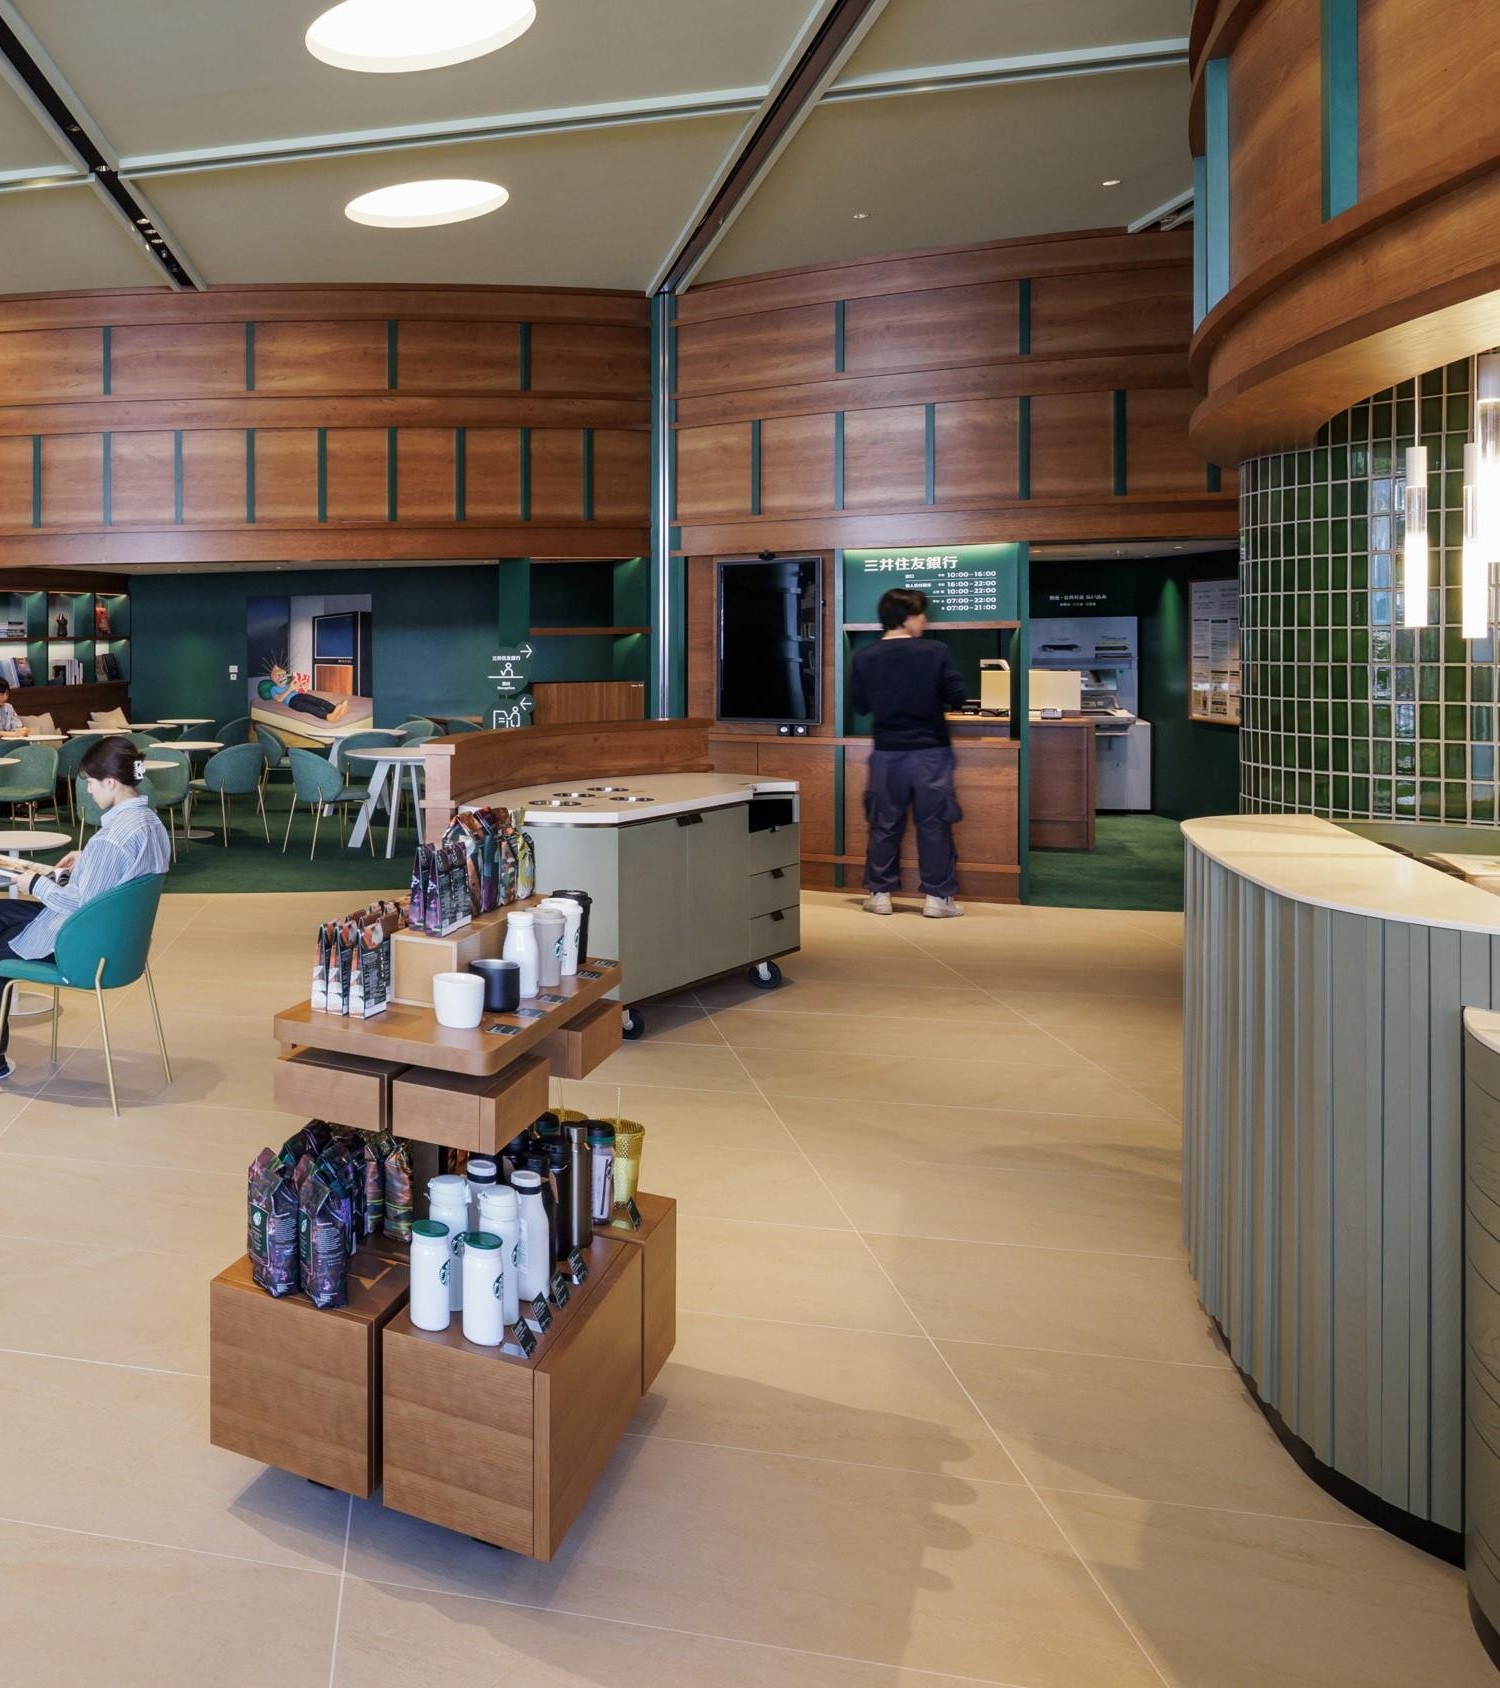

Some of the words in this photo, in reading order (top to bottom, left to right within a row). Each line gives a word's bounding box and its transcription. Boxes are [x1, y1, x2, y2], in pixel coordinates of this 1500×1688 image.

[864, 556, 958, 572] 三井住友銀行
